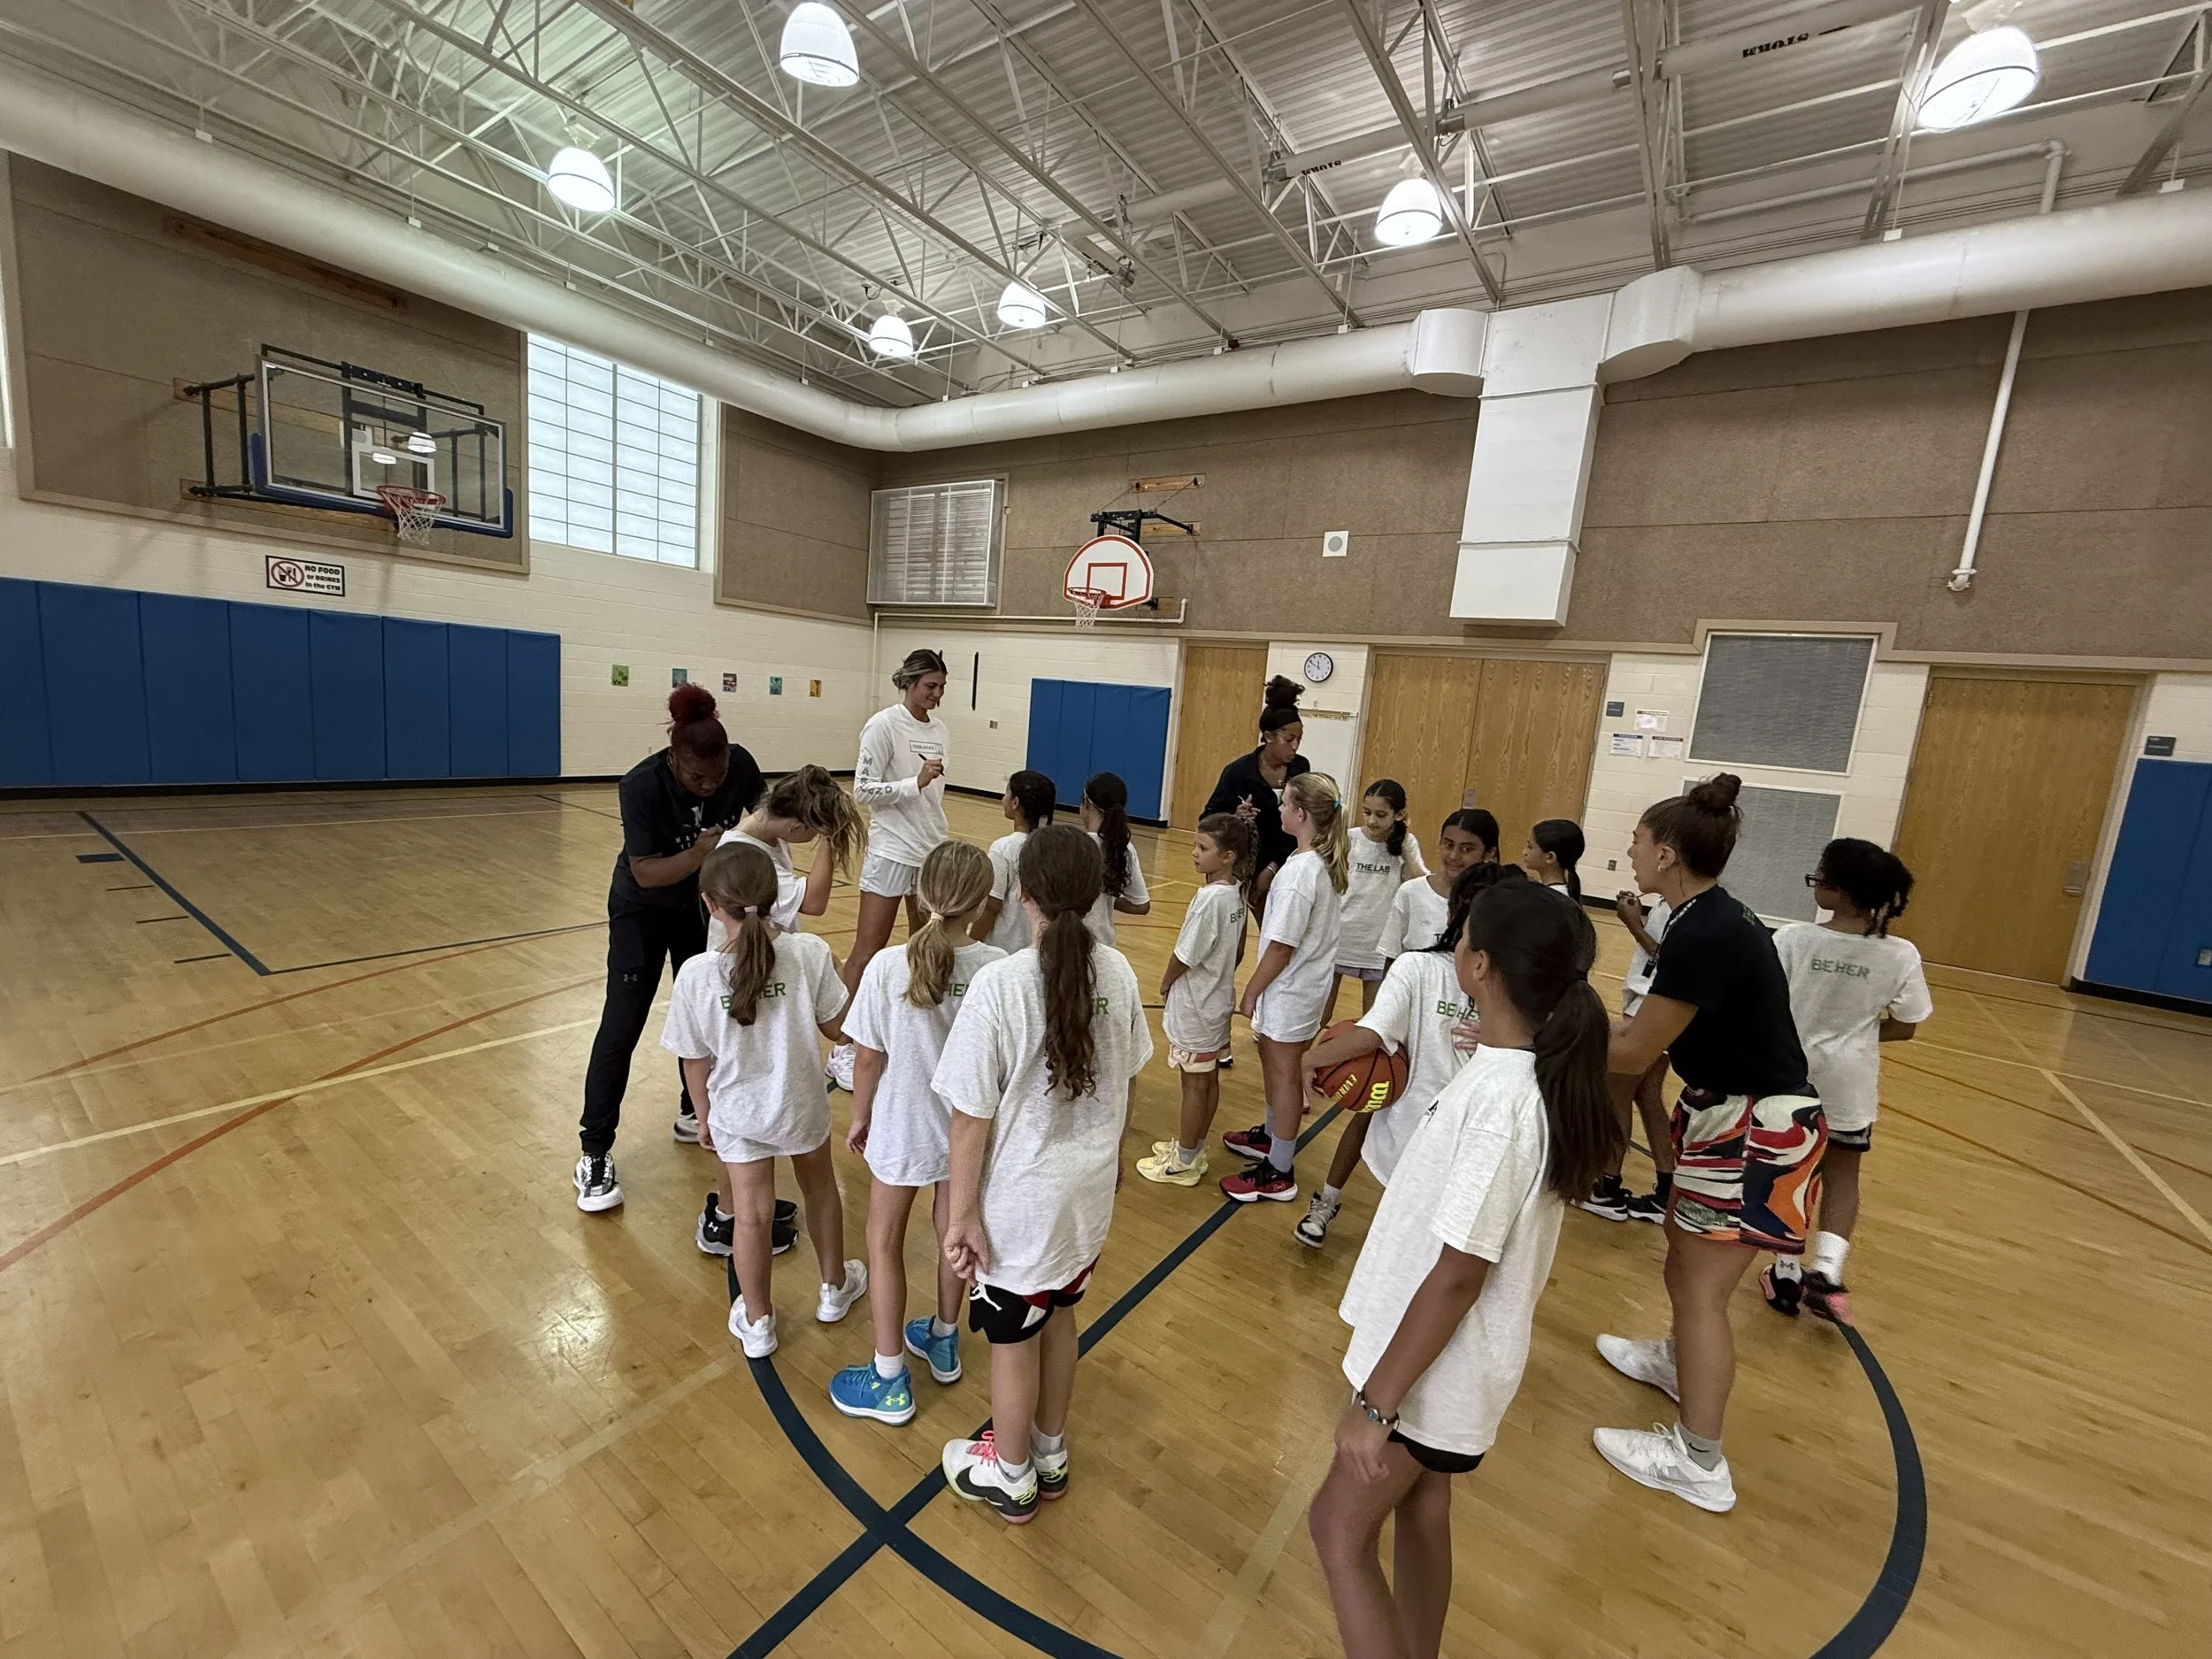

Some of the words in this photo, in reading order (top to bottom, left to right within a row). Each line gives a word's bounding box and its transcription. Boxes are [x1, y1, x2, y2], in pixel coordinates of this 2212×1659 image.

[318, 566, 341, 575] FOOD
[1356, 862, 1373, 872] THE
[1373, 864, 1390, 873] LAB
[720, 982, 787, 1010] BER
